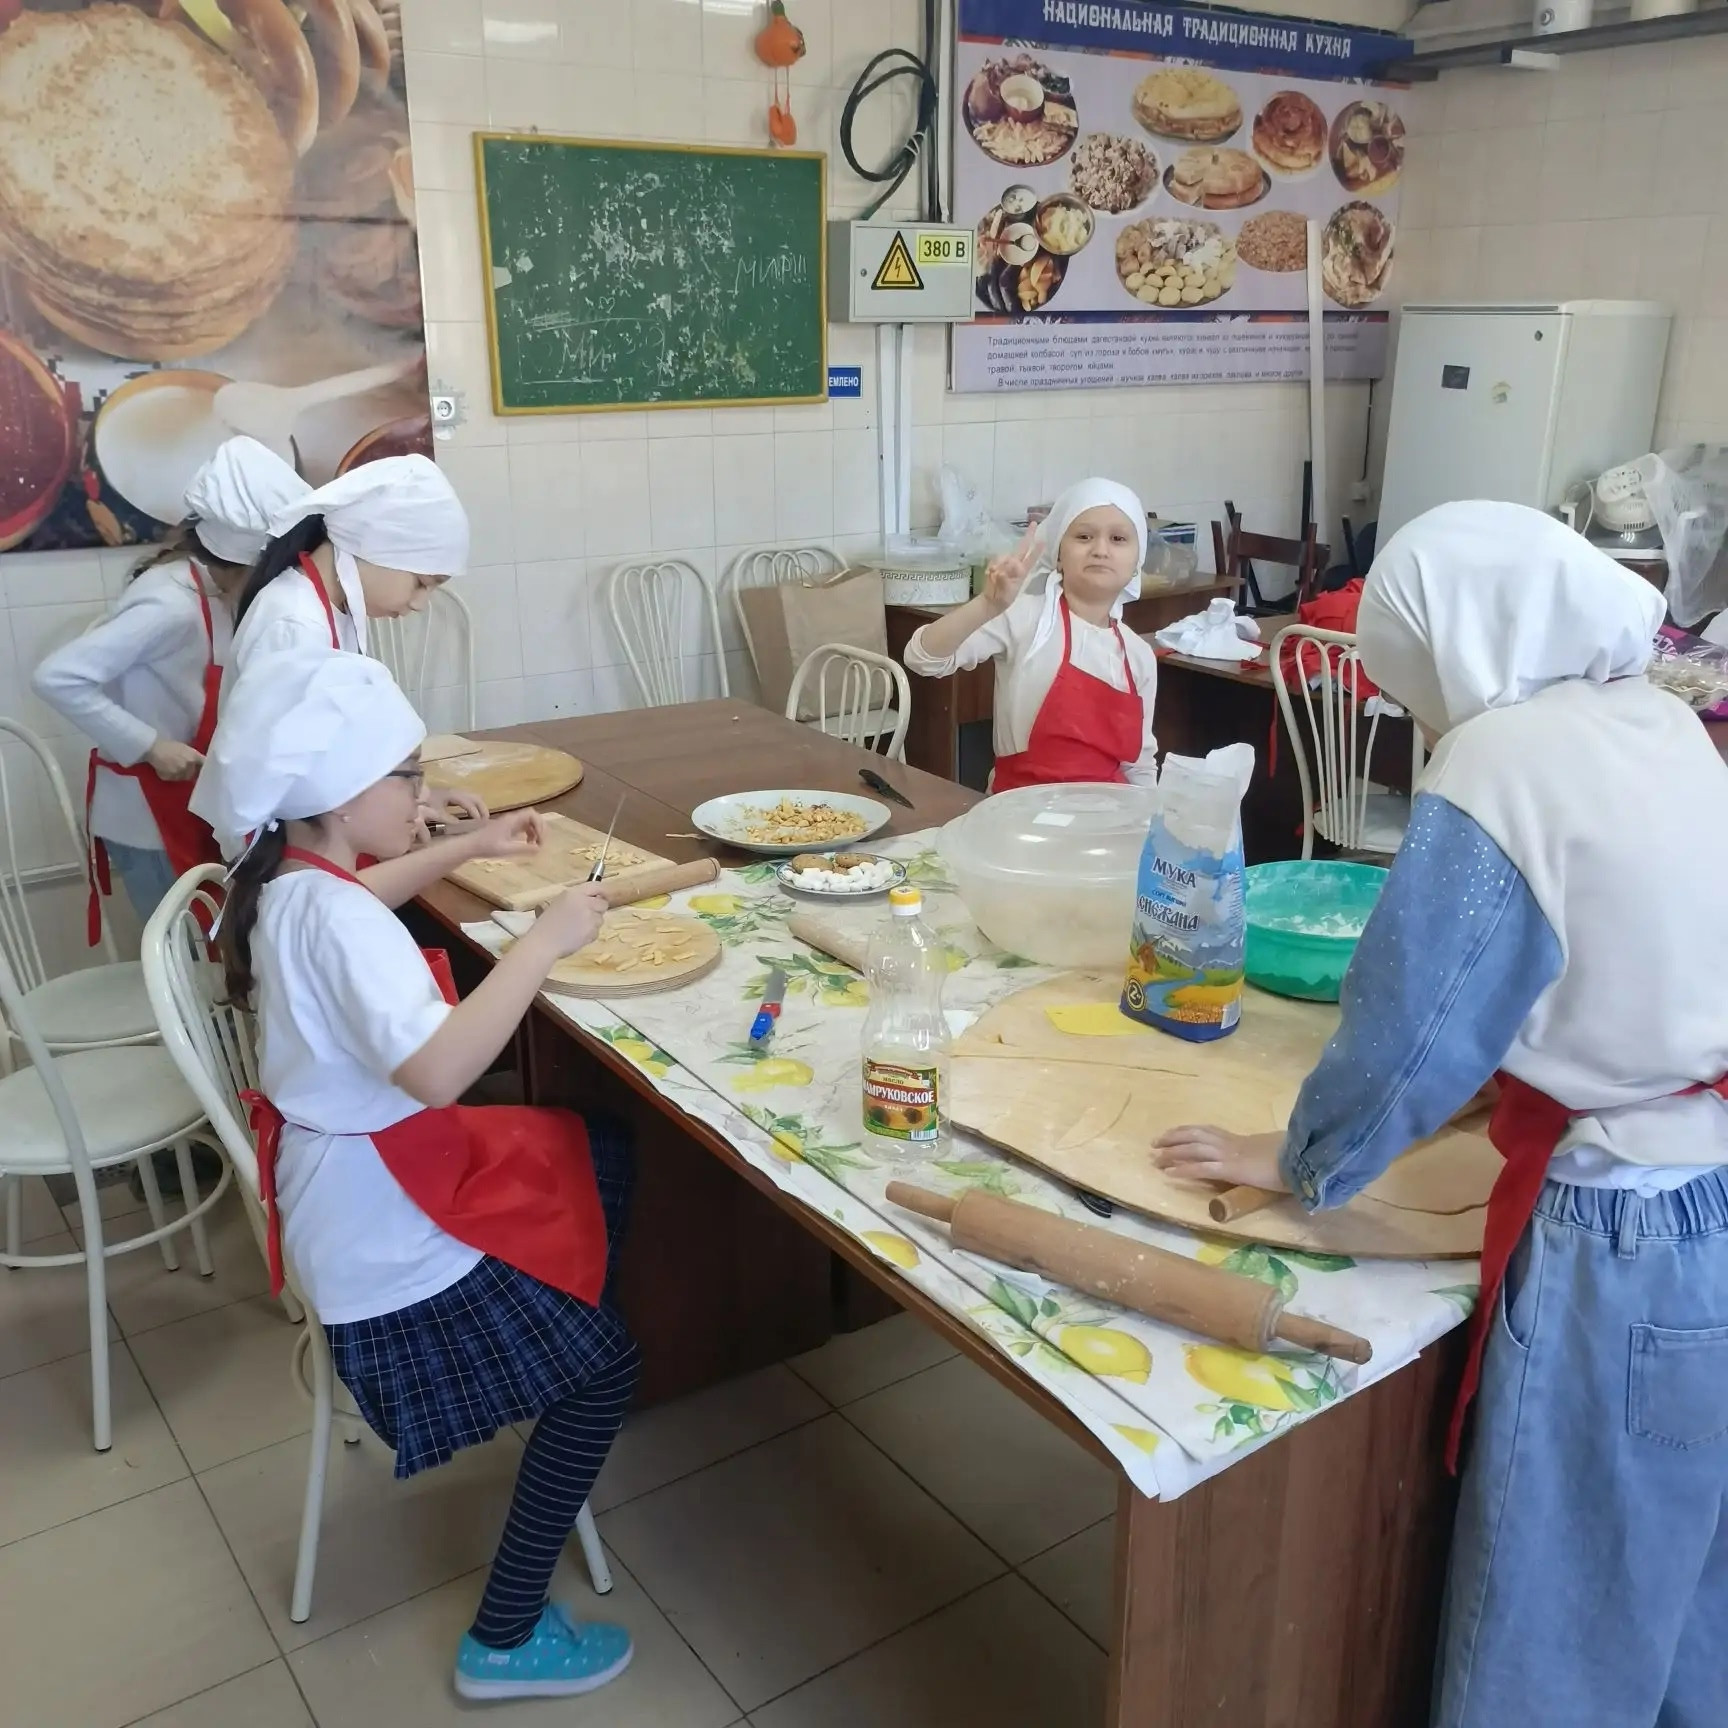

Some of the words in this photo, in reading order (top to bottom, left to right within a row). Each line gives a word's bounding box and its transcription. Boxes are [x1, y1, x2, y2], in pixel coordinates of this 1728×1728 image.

[1043, 0, 1173, 37] НАЦИОНАЛЬНАЯ
[1183, 16, 1298, 52] ТРАДИЦИОННАЯ
[1305, 33, 1352, 59] КУХНЯ
[923, 240, 951, 258] 380
[955, 241, 966, 258] В
[987, 336, 1049, 346] Традиционными
[1052, 335, 1088, 344] блюдами
[987, 351, 1028, 360] домашней
[828, 376, 859, 387] ЕМЛЕНО
[1152, 857, 1197, 888] МУКА
[1137, 895, 1200, 931] СНЕЖАНА
